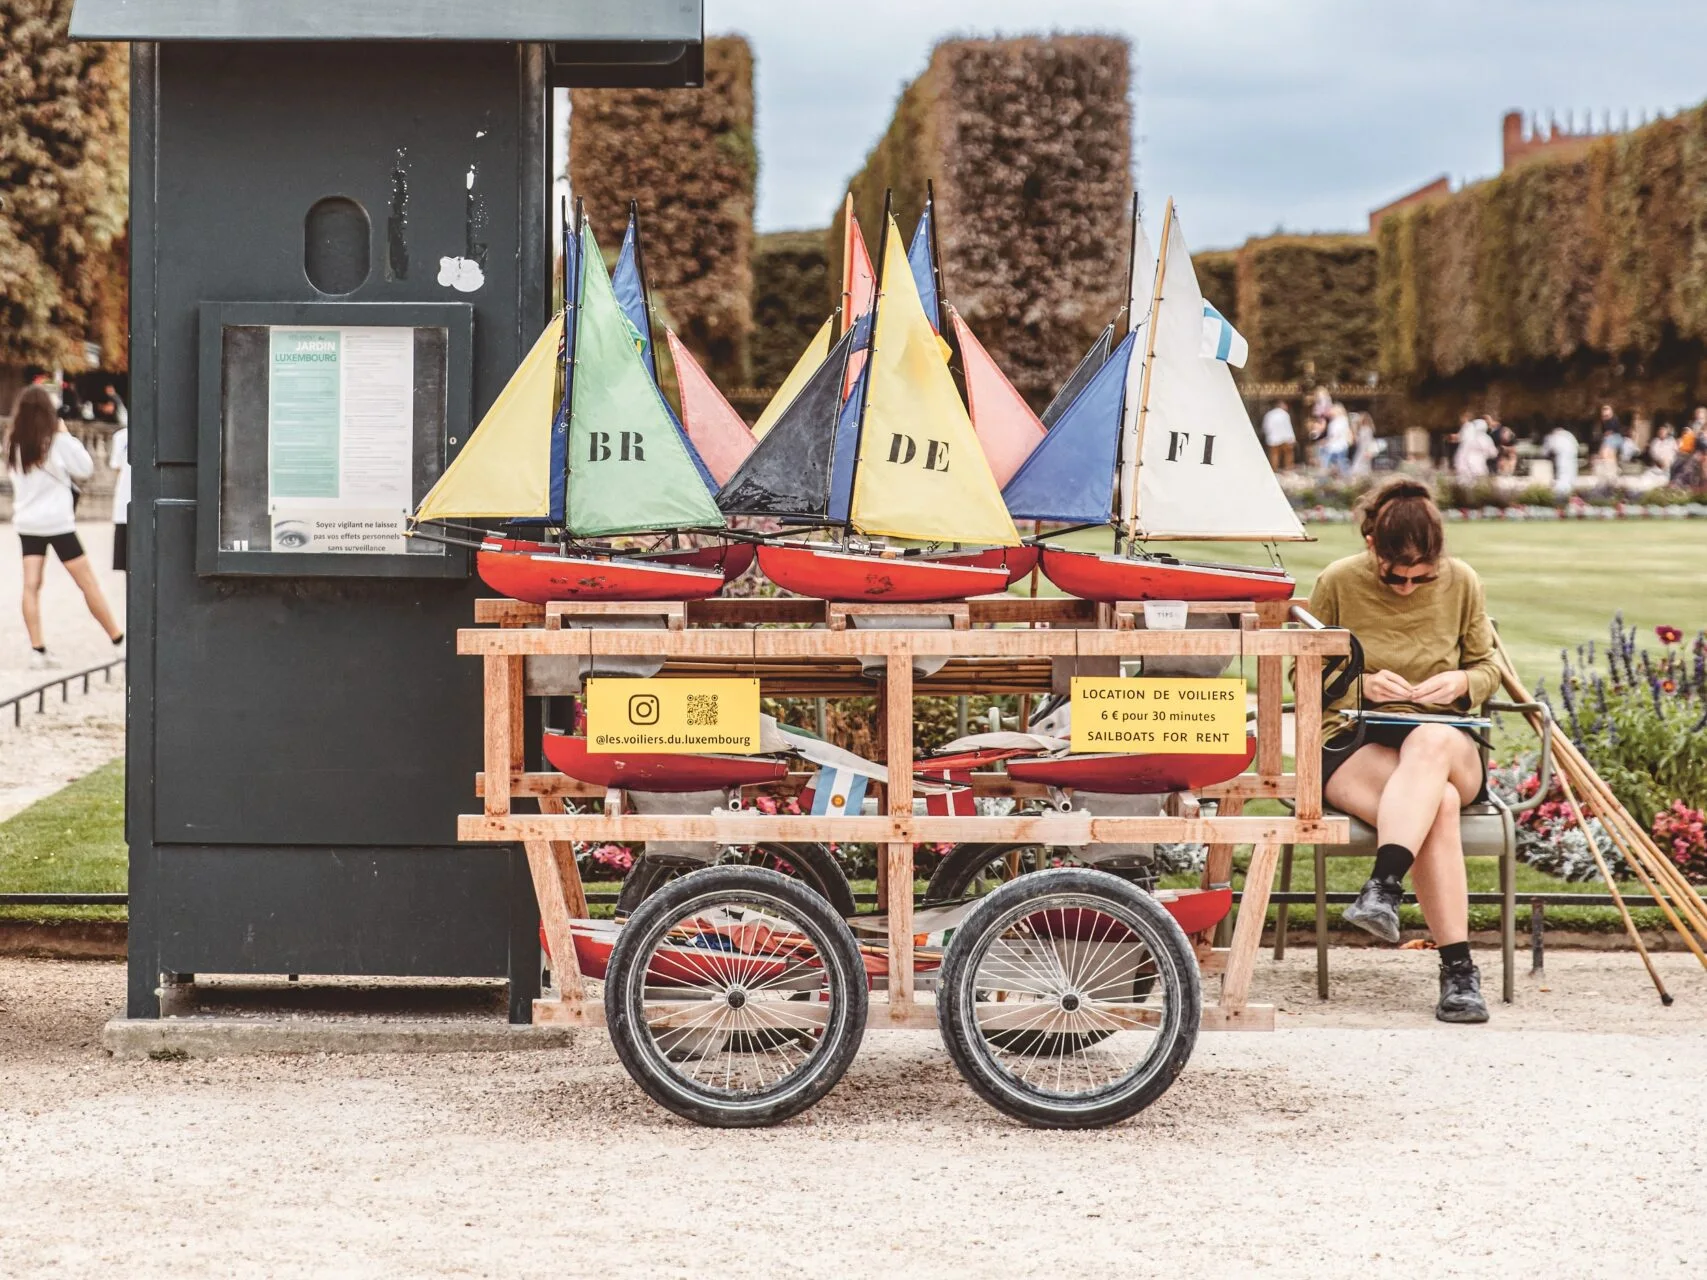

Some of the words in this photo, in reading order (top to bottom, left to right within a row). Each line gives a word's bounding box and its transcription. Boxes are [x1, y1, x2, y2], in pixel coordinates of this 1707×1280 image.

[296, 341, 336, 352] JARDIN
[275, 353, 337, 362] LUXEMBOURG
[588, 431, 646, 462] BR
[886, 432, 950, 473] DE
[1165, 430, 1217, 466] FI
[316, 521, 335, 529] Soyez
[338, 521, 363, 529] vigilant
[341, 532, 360, 540] effets
[345, 544, 386, 552] surveillance
[1082, 689, 1145, 700] LOCATION
[1153, 691, 1170, 700] DE
[1178, 691, 1235, 701] VOILIERS
[1101, 711, 1108, 720] 6
[1112, 711, 1119, 720] €
[1122, 712, 1149, 723] pour
[1152, 711, 1166, 721] 30
[1169, 711, 1216, 722] minutes
[596, 734, 751, 747] @les.voiliers.du.luxembourg
[1087, 731, 1155, 742] SAILBOATS
[1163, 732, 1188, 742] FOR
[1196, 732, 1230, 743] RENT
